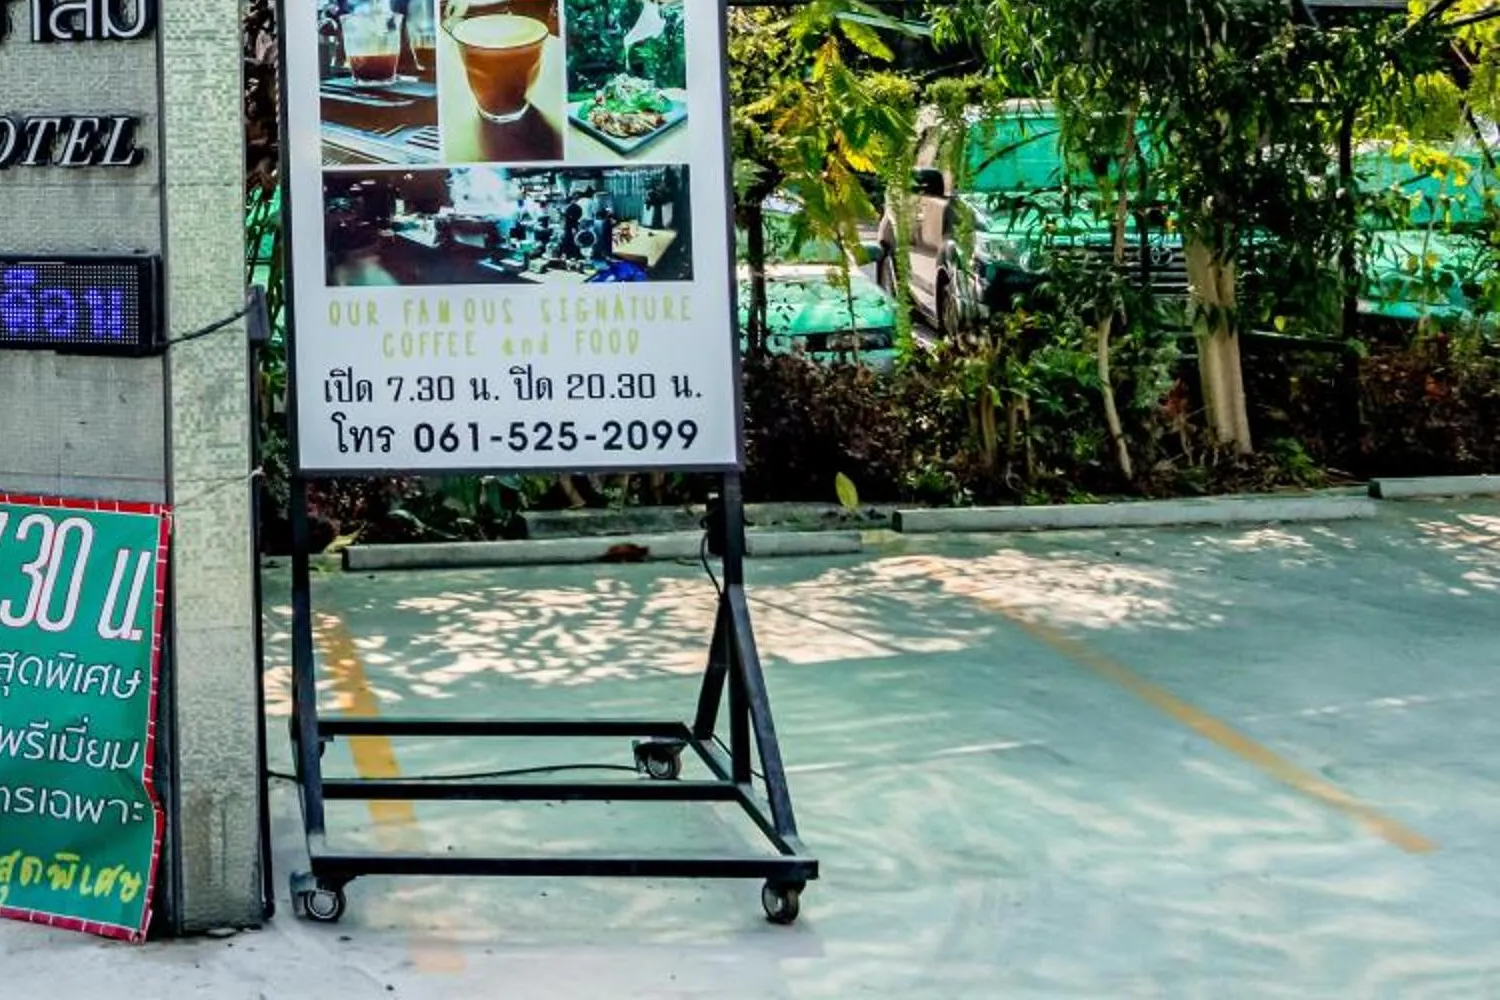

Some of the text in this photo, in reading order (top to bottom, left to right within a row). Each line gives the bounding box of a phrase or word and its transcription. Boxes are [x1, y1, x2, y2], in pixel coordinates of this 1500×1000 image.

[328, 295, 693, 326] OUR FAMOUS SIGNATURE
[383, 328, 641, 358] COFFEE and FOOD
[324, 364, 703, 403] เปิด 7.30 น. ปิด 20.30 น.
[331, 412, 699, 453] โทร 061-525-2099
[99, 547, 153, 642] น.
